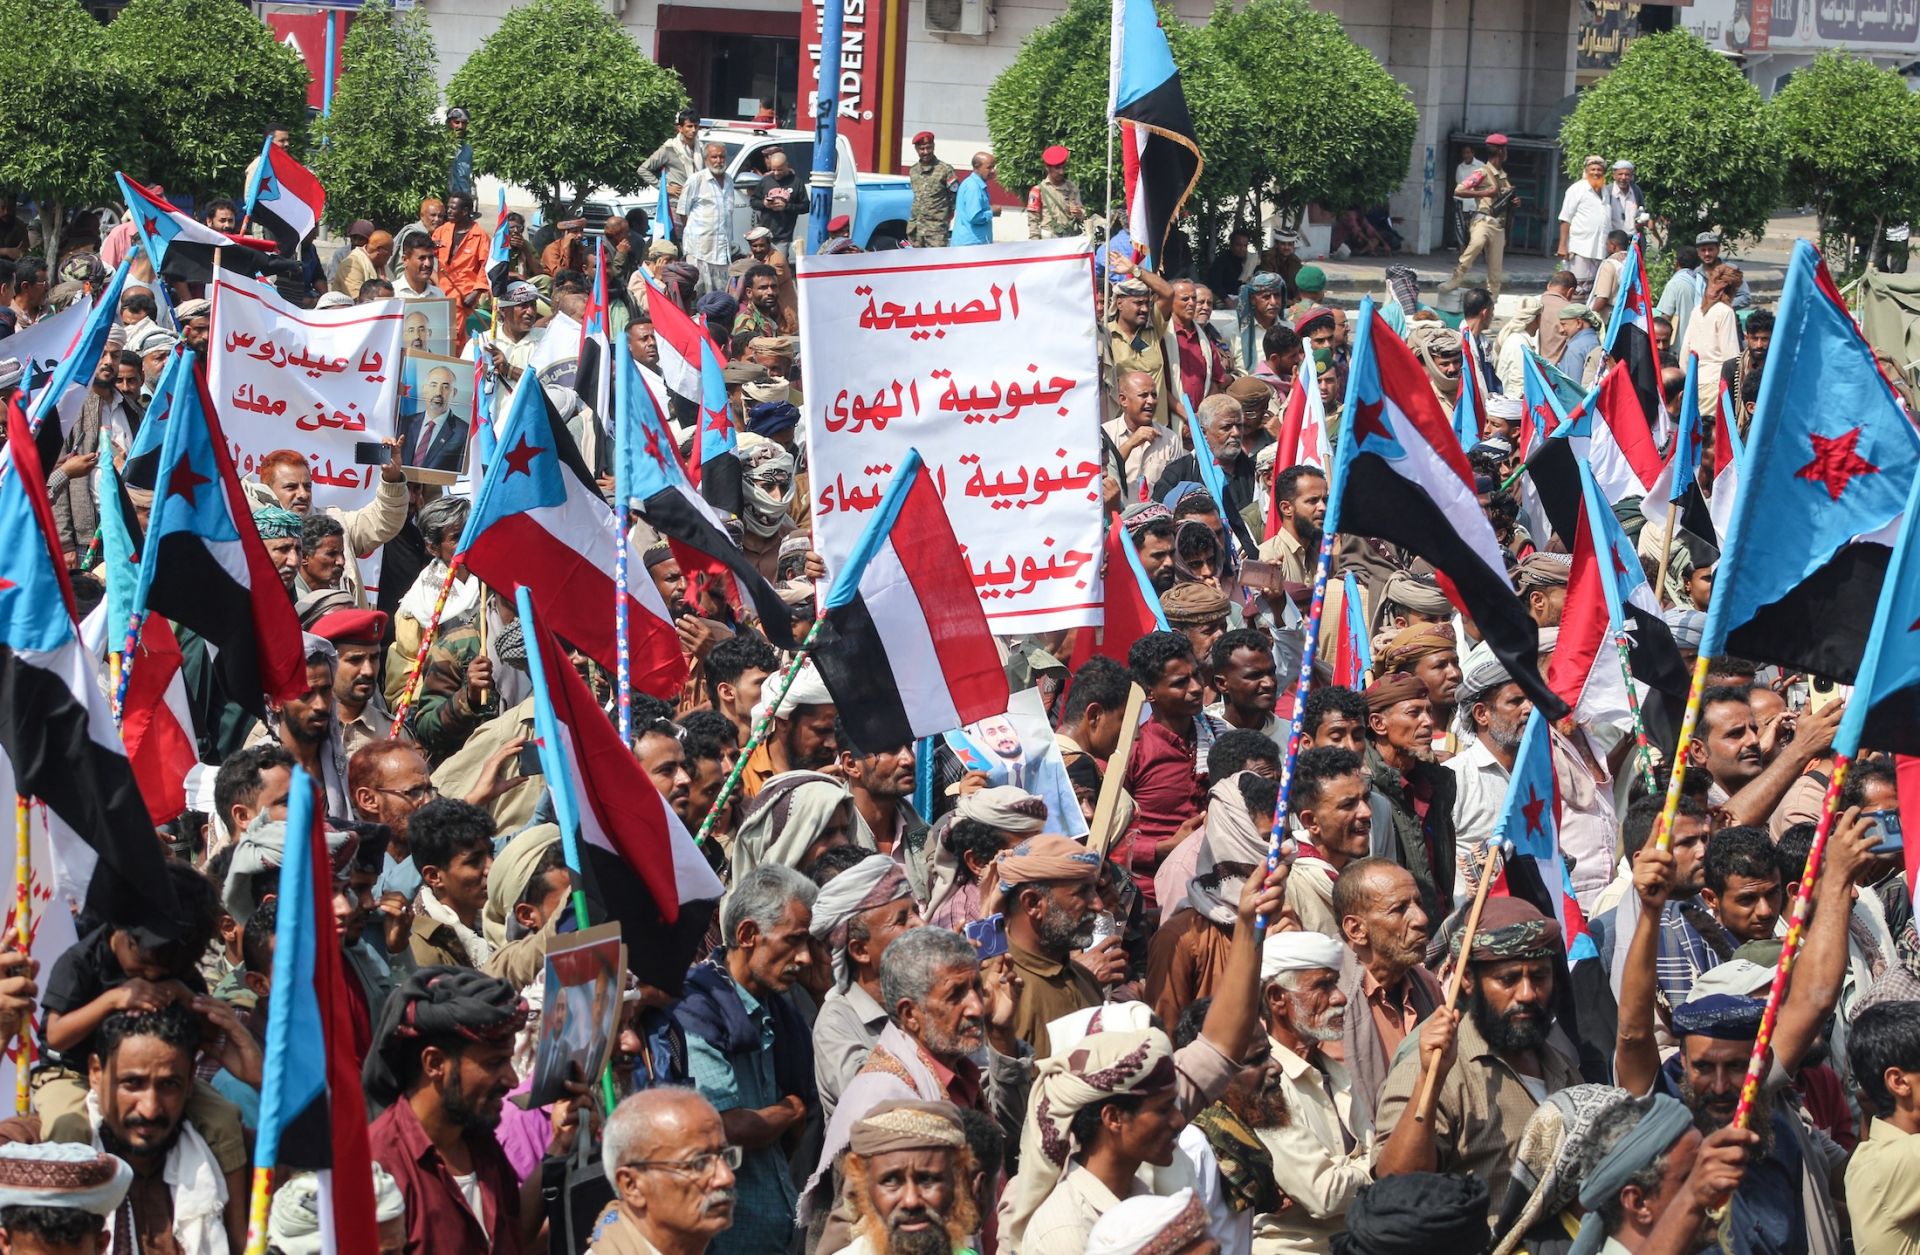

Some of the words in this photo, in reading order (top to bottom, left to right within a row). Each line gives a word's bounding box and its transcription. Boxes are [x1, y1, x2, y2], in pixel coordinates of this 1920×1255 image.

[838, 30, 864, 119] ADEN
[854, 282, 1020, 341] الصبيحة
[226, 330, 350, 378] عيدروس
[357, 347, 387, 383] يا
[232, 383, 287, 416] معك
[295, 402, 366, 432] نحن
[825, 378, 920, 433] الهوى
[930, 363, 1077, 425] جنوبية
[959, 447, 1102, 510] جنوبية
